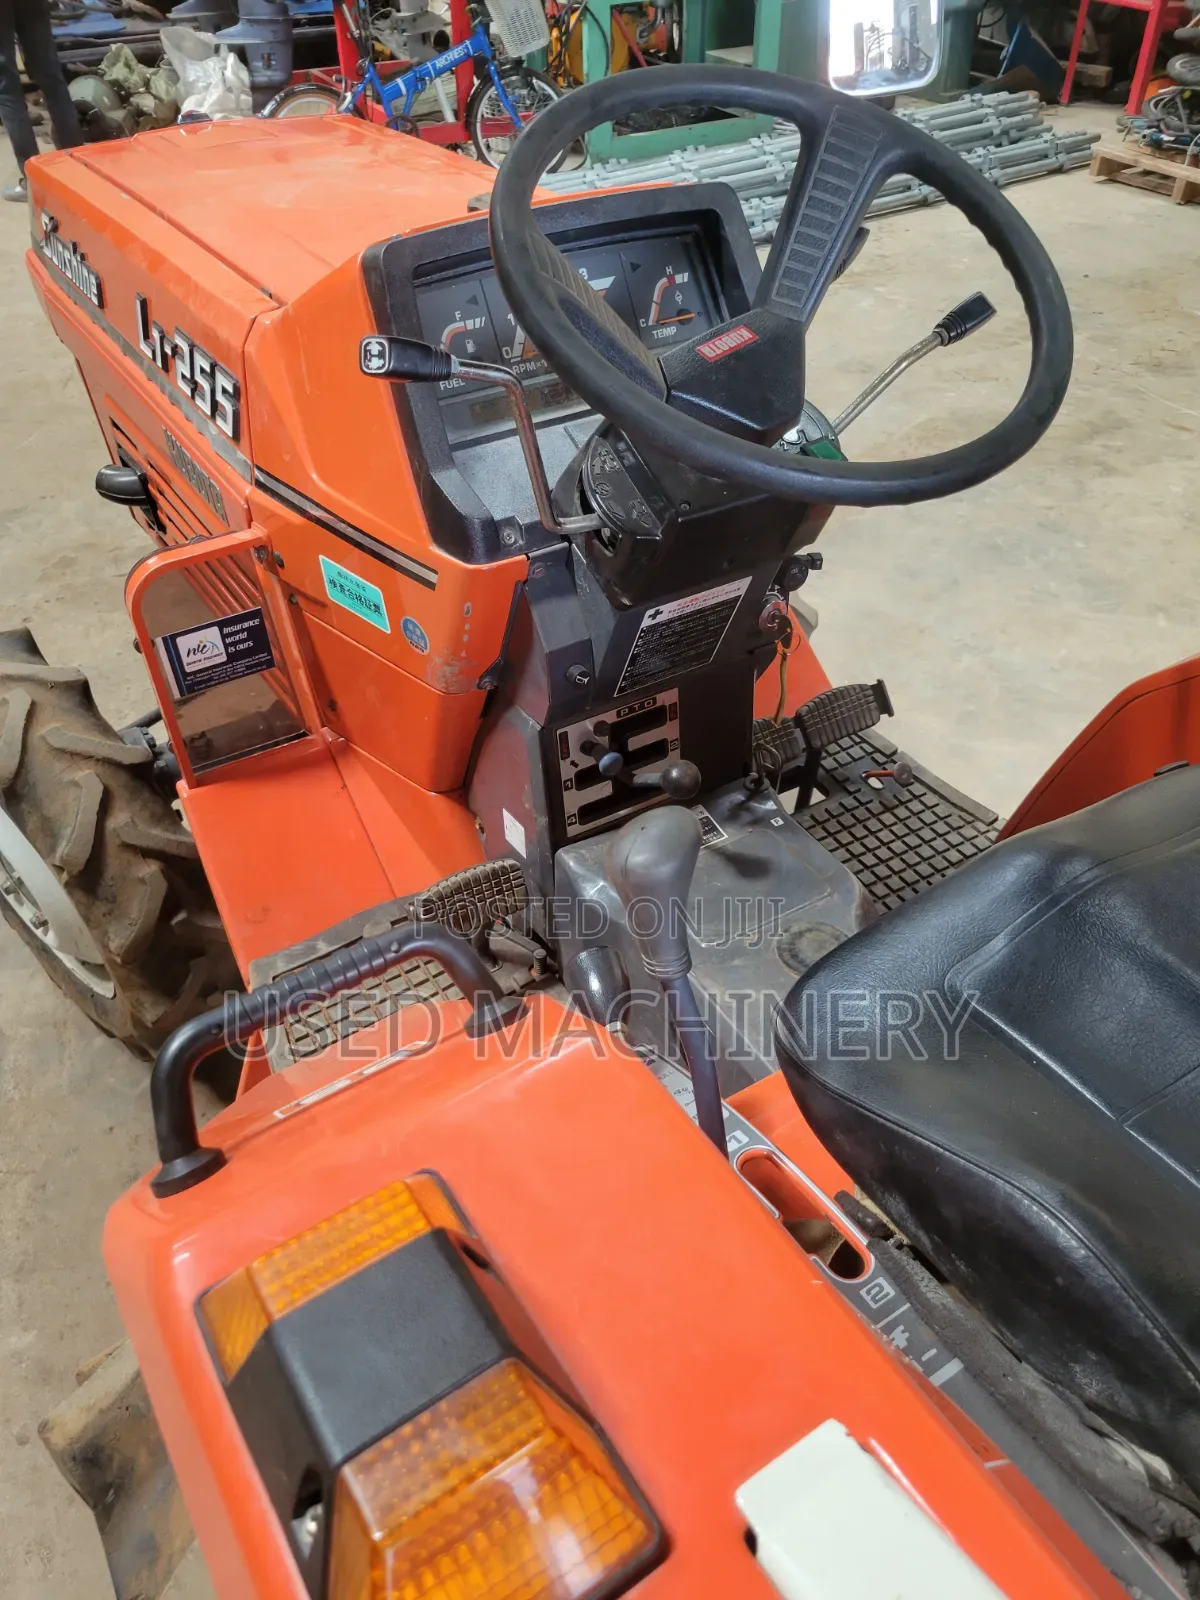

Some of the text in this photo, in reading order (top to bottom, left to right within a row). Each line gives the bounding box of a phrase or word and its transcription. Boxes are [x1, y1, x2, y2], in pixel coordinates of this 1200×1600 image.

[40, 211, 100, 308] Sunshine
[579, 267, 588, 280] 3
[665, 265, 674, 276] H
[454, 310, 463, 321] F
[639, 318, 647, 328] C
[652, 325, 677, 339] TEMP
[699, 327, 754, 359] KUBOTA
[440, 377, 466, 391] FUEL
[223, 618, 260, 634] Insurance
[225, 631, 248, 644] world
[228, 640, 254, 653] is ours
[669, 740, 679, 749] 2
[567, 816, 576, 824] 4
[864, 1282, 891, 1308] 2
